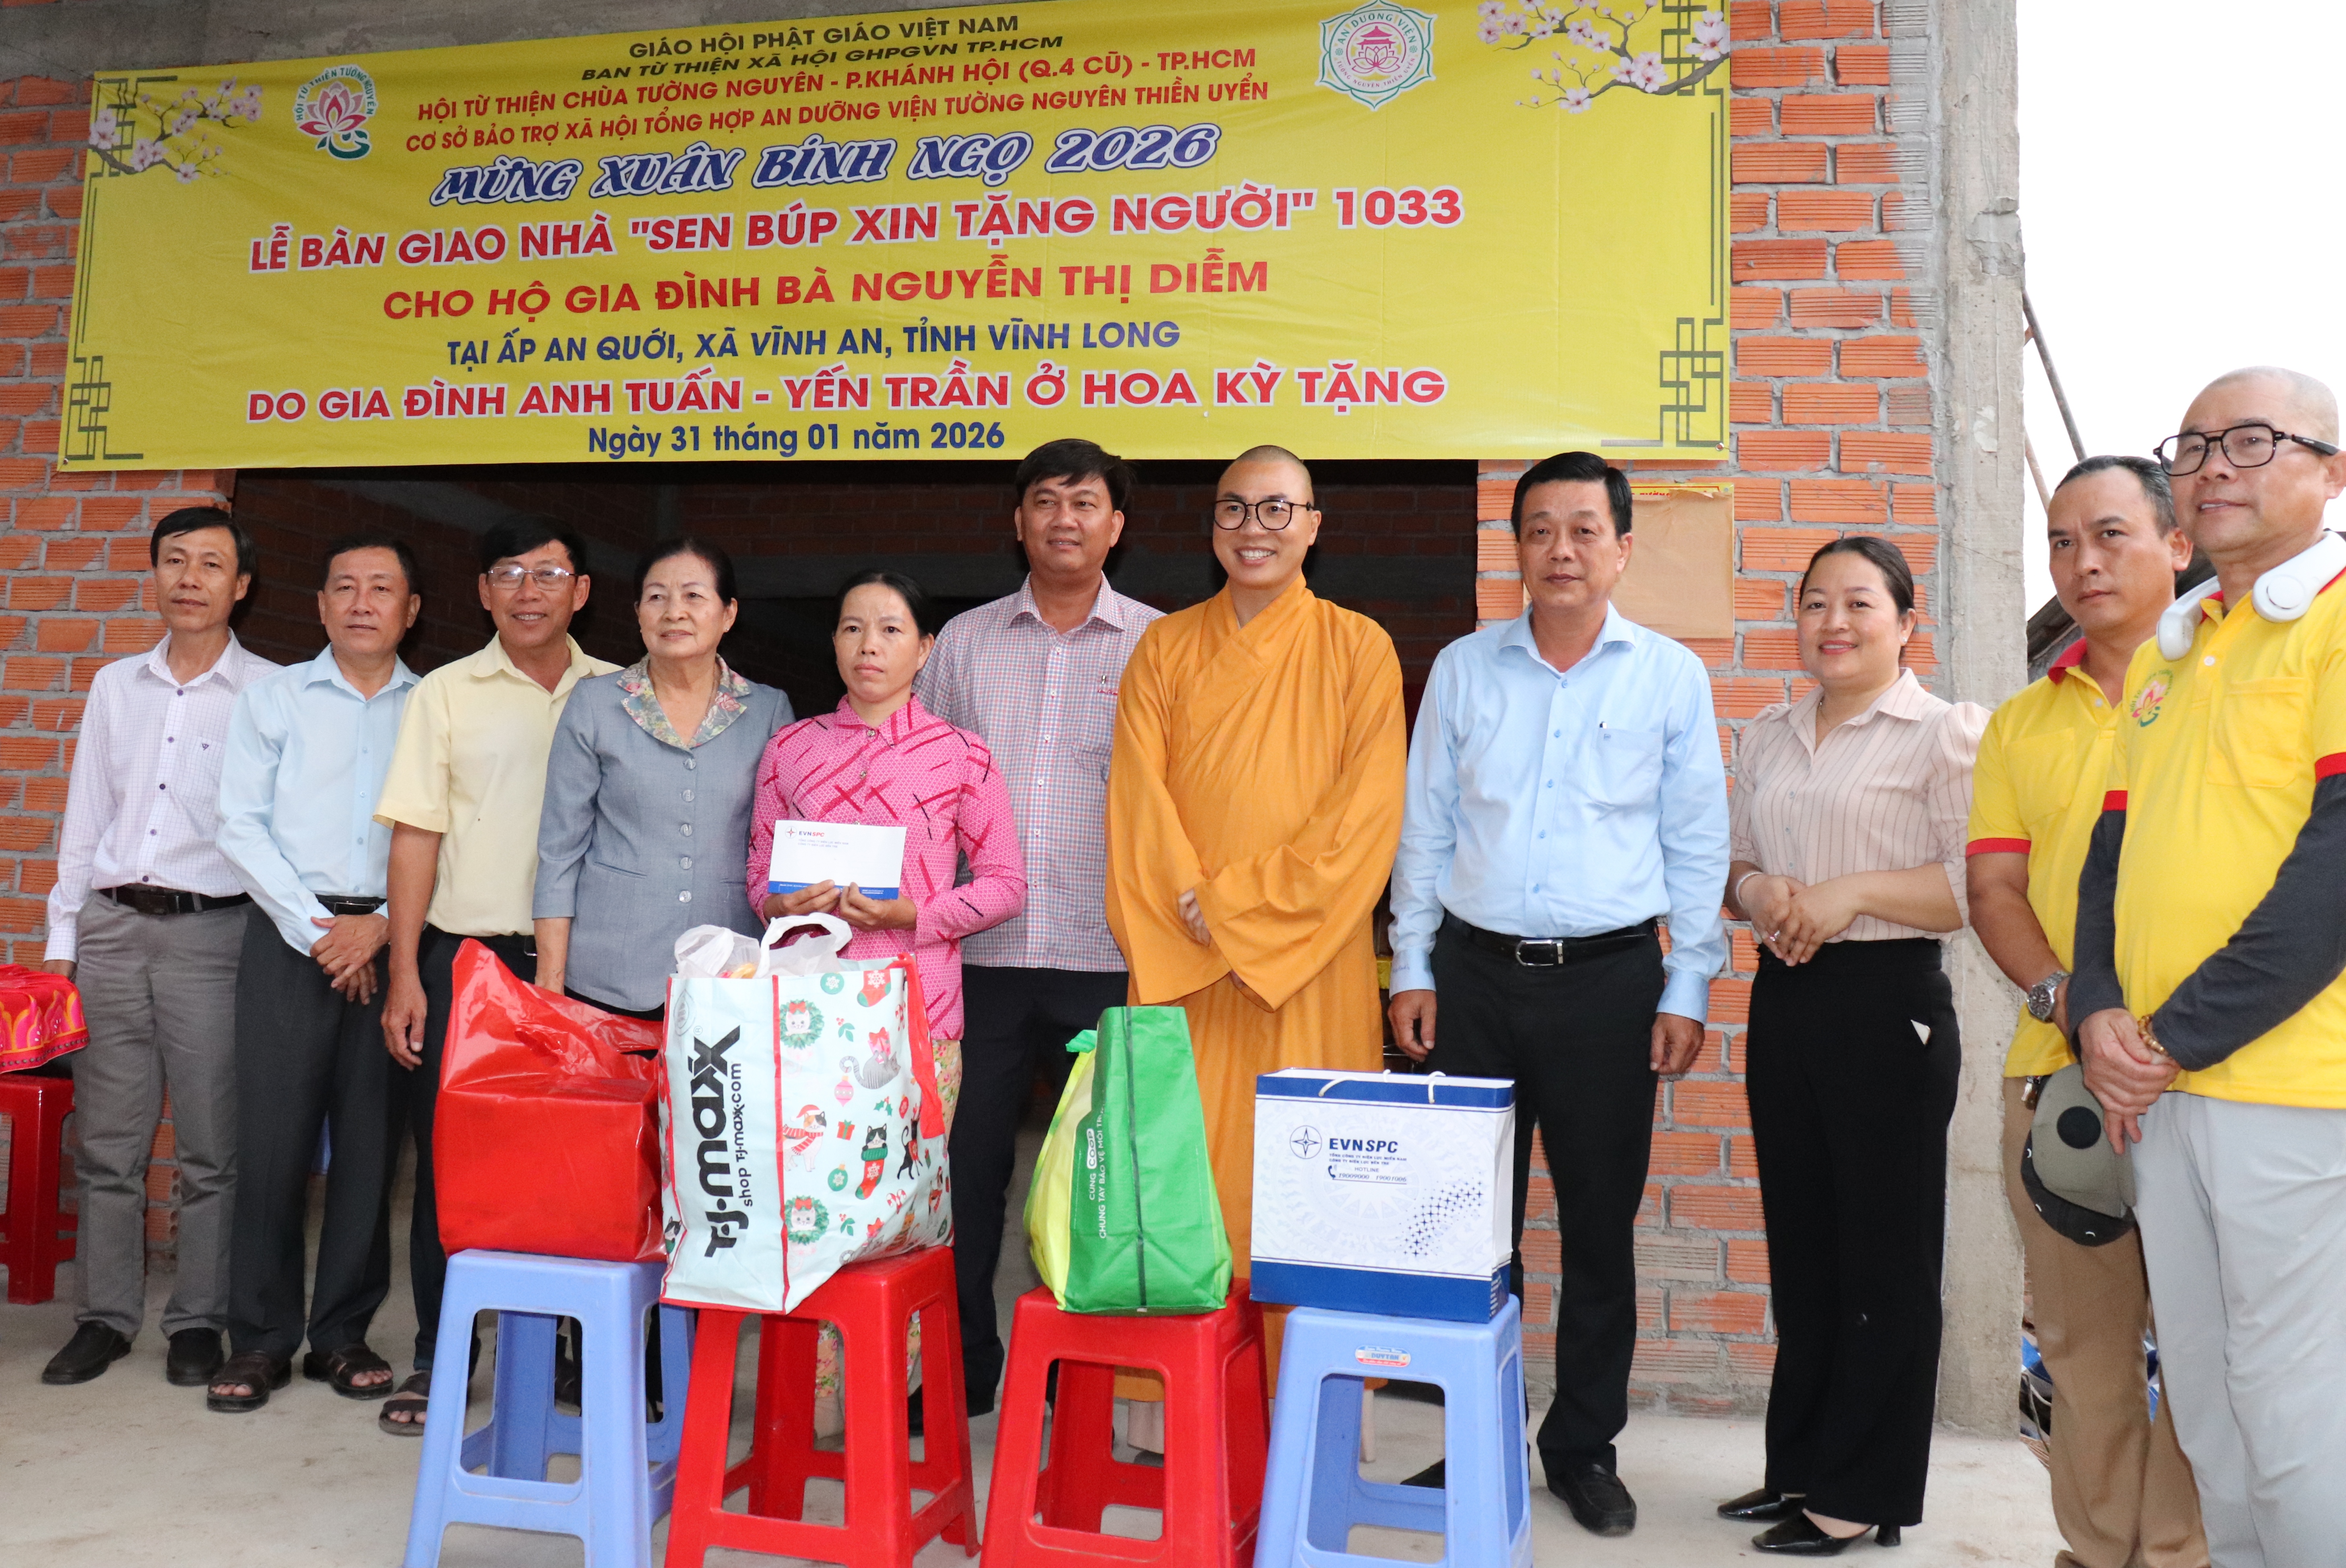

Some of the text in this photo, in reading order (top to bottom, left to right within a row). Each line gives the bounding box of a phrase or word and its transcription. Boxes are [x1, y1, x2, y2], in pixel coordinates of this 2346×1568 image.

[581, 36, 1063, 81] BAN TỪ THIỆN XÃ HỘI GHPGVN TP.HCM
[629, 15, 1018, 58] GIÁO HỘI PHẬT GIÁO VIỆT NAM
[1337, 29, 1350, 44] AN
[418, 97, 457, 124] HỘI
[464, 94, 490, 117] TỪ
[496, 90, 556, 116] THIỆN
[563, 85, 628, 109] CHÙA
[636, 80, 718, 103] TƯỜNG
[726, 71, 824, 98] NGUYÊN
[846, 65, 954, 89] P.KHÁNH
[963, 58, 1010, 86] HỘI
[1018, 57, 1075, 83] (Q.4
[1083, 51, 1133, 78] CŨ)
[1157, 48, 1256, 71] TP.HCM
[294, 103, 304, 120] HỘI
[406, 72, 1268, 152] CƠ SỞ BẢO TRỢ XÃ HỘI TỔNG HỢP AN DƯỠNG VIỆN TƯỜNG NGUYÊN THIỀN UYỂN
[429, 123, 1222, 207] MỪNG XUÂN BÍNH NGỌ 2026
[252, 183, 1461, 270] LỄ BÀN GIAO NHÀ "SEN BÚP XIN TẶNG NGƯỜI" 1033
[383, 248, 1268, 322] CHO HỘ GIA ĐÌNH BÀ NGUYỄN THỊ DIỄM
[447, 316, 1179, 372] TẠI ẤP AN QUỚI, XÃ VĨNH AN, TỈNH VĨNH LONG
[249, 392, 306, 420] DO
[319, 390, 390, 419] GIA
[404, 380, 505, 417] ĐÌNH
[519, 384, 610, 414] ANH
[625, 367, 741, 412] TUẤN
[784, 364, 868, 408] YẾN
[885, 359, 1008, 407] TRẦN
[1027, 363, 1065, 405] Ở
[1084, 372, 1197, 405] HOA
[1217, 362, 1281, 403] KỲ
[1298, 363, 1445, 412] TẶNG
[589, 421, 1004, 459] Ngày 31 tháng 01 năm 2026
[1087, 1130, 1096, 1167] COOP
[738, 1167, 753, 1207] shop
[1098, 1204, 1107, 1239] CHUNG
